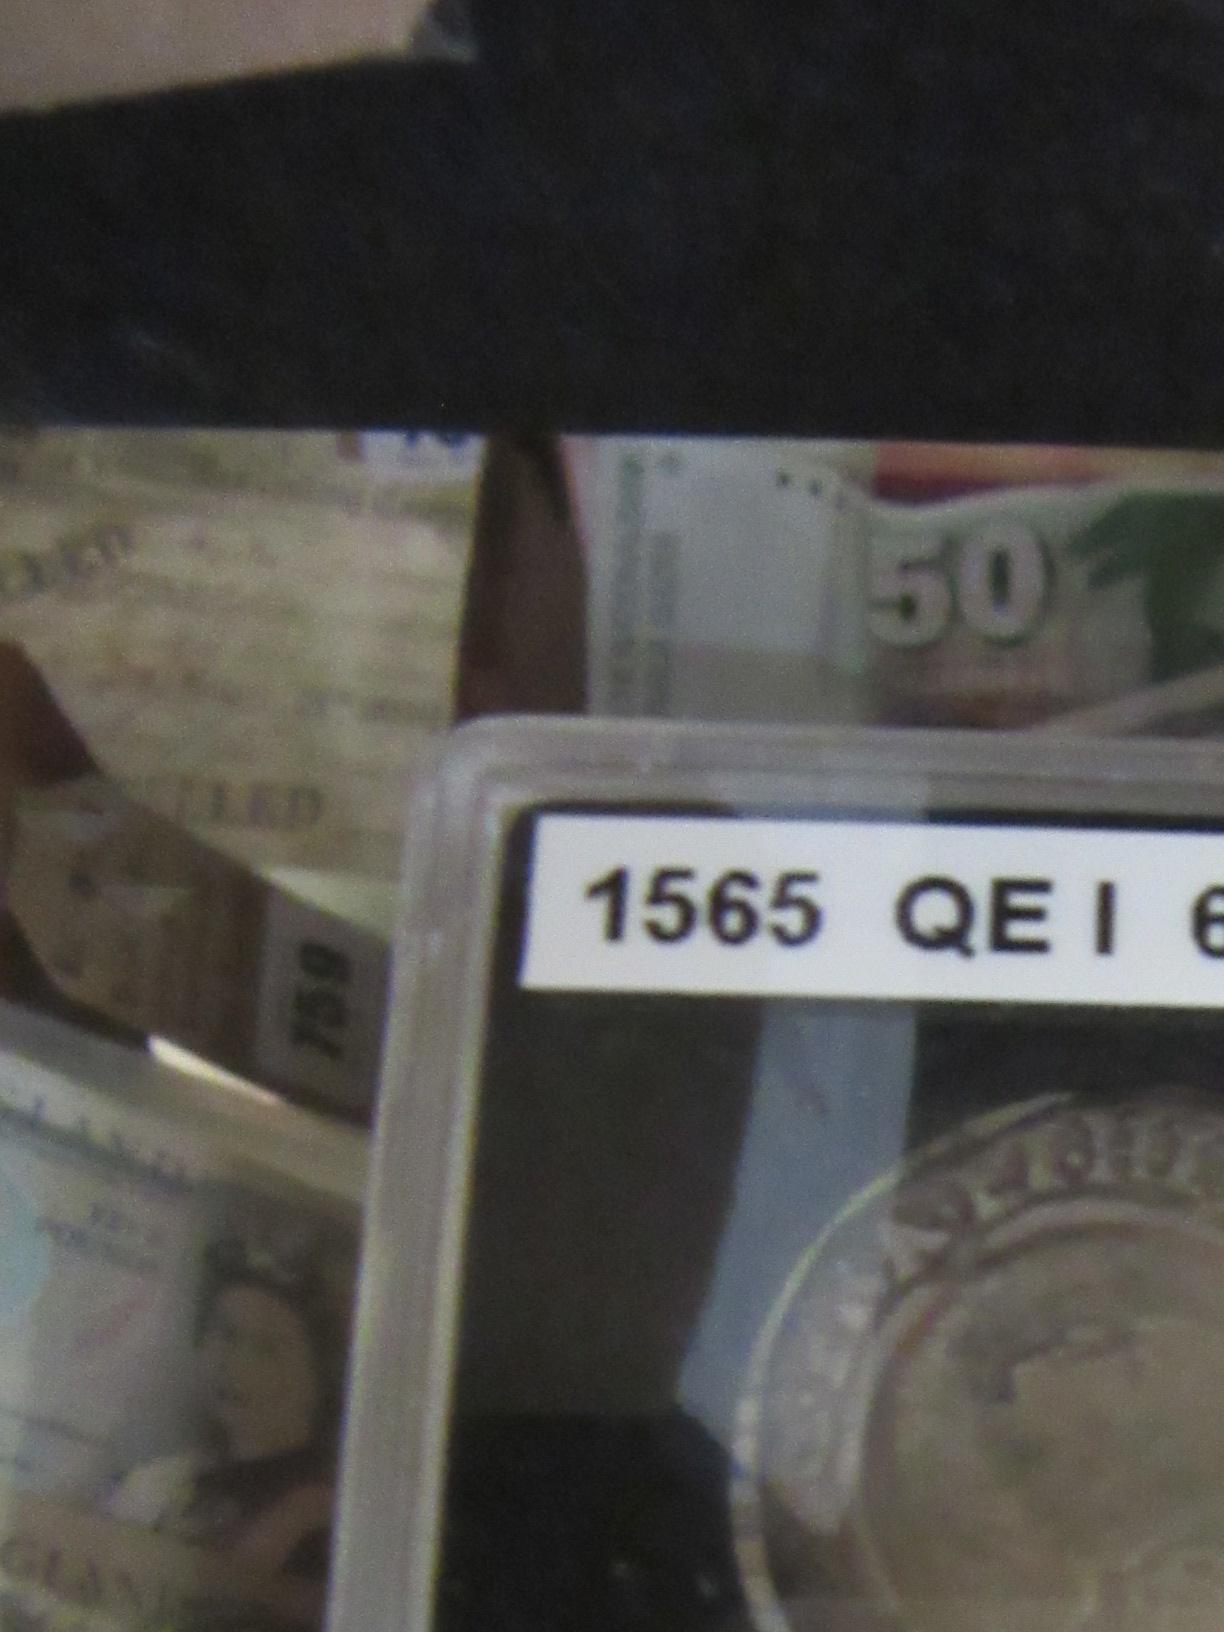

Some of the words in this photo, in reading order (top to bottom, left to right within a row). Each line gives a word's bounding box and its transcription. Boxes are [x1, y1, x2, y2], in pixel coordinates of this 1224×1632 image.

[867, 515, 1055, 648] 50
[585, 864, 822, 947] 1565
[895, 874, 1054, 959] QE
[1094, 880, 1117, 956] I
